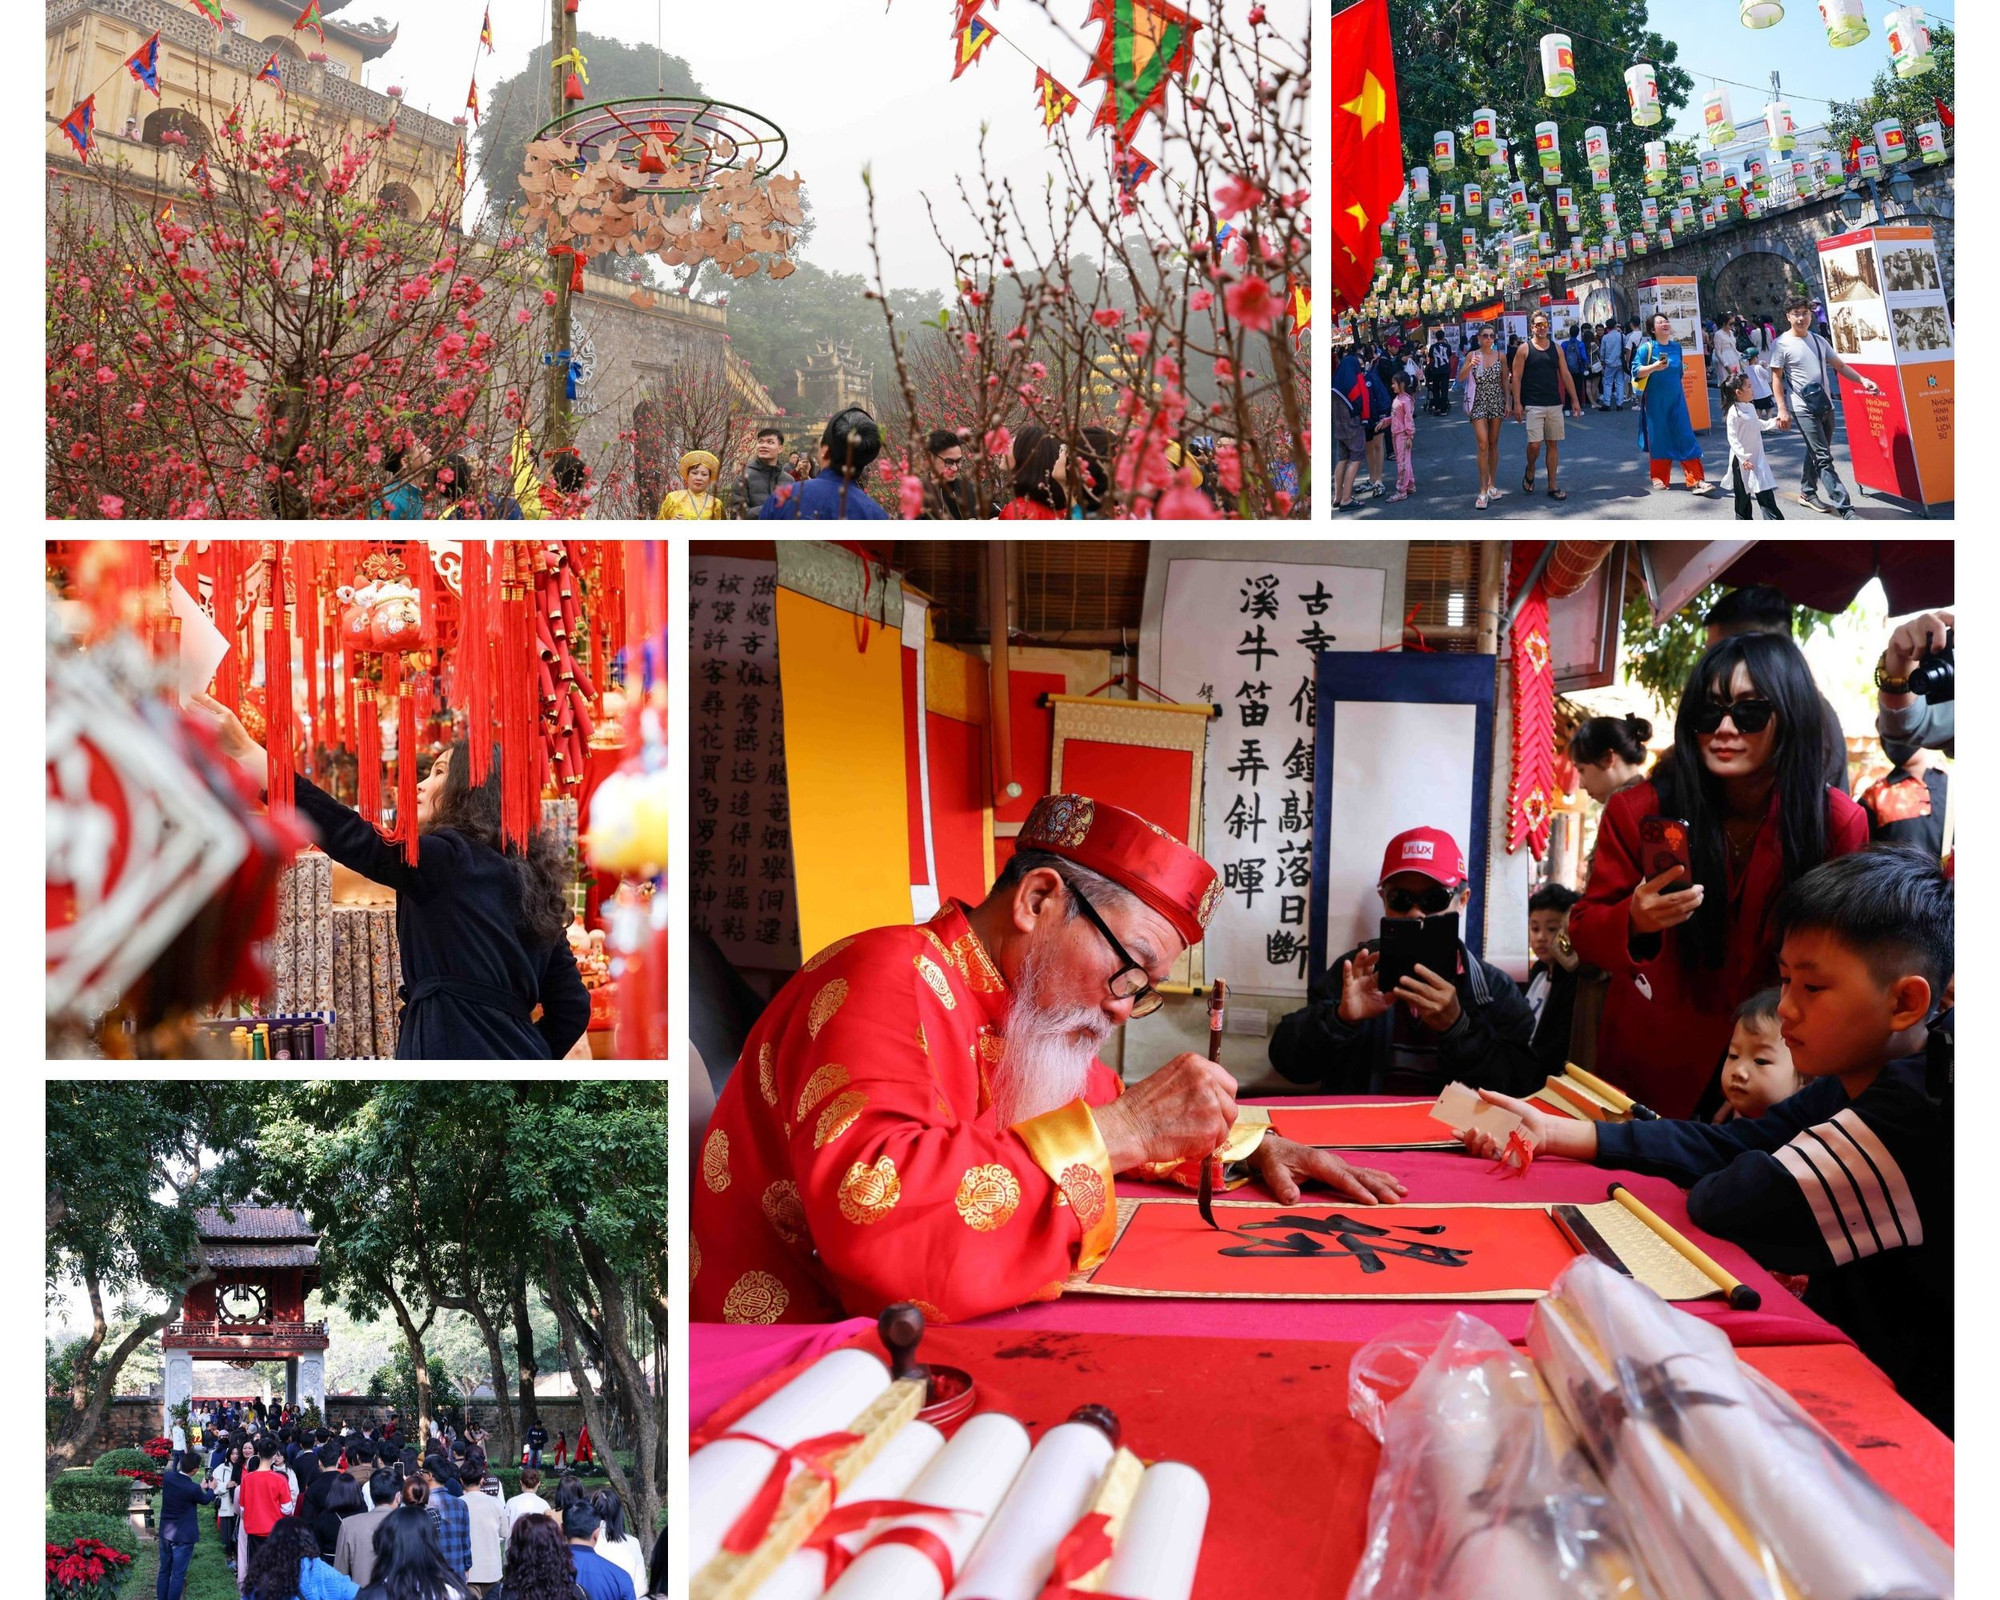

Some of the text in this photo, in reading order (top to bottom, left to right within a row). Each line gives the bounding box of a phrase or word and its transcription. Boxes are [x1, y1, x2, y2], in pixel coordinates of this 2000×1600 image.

[1223, 573, 1280, 909] 溪牛笛弄斜暉
[1404, 845, 1432, 855] ULUX
